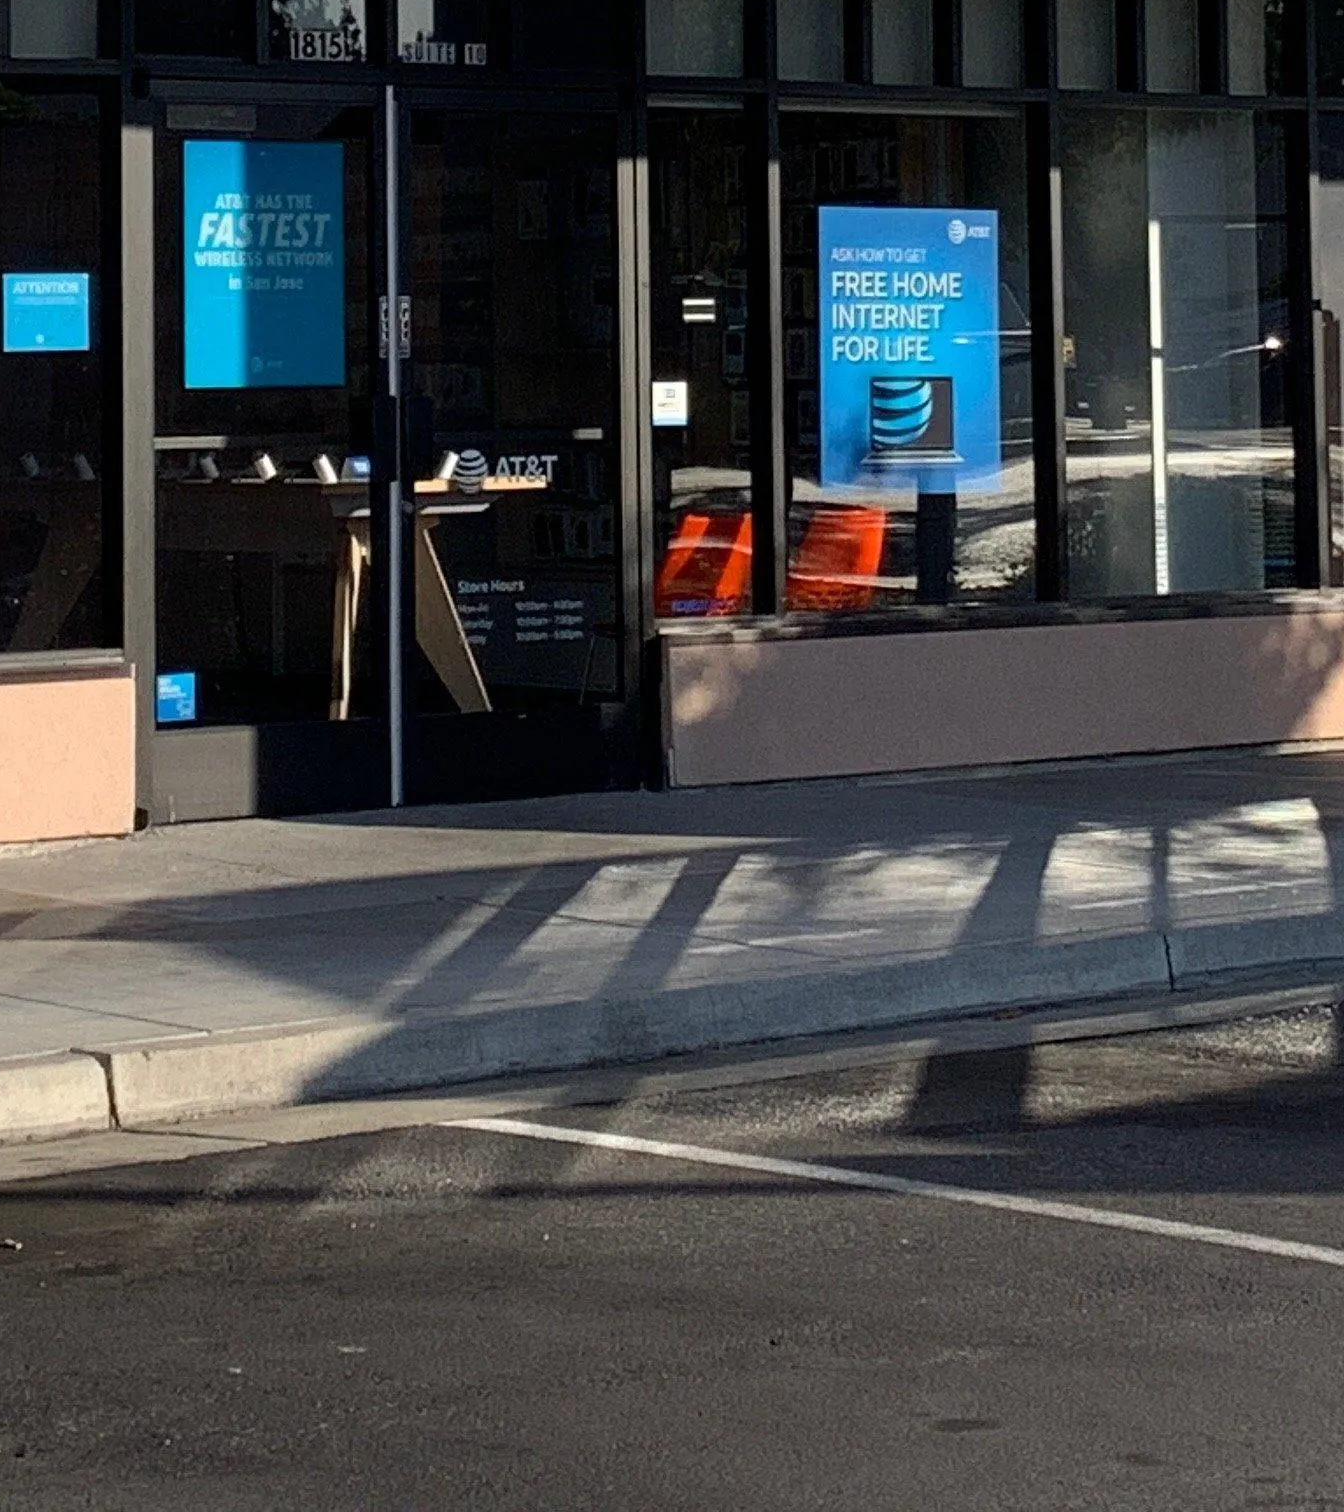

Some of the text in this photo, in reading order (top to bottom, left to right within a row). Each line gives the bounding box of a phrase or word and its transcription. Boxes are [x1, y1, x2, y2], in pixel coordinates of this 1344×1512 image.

[215, 193, 313, 209] AT&T HAS THE
[197, 212, 331, 248] FASTEST
[968, 226, 992, 238] AT&T
[194, 250, 334, 267] WIRELESS NETWORK
[831, 247, 927, 263] ASK HOW TO GET
[229, 273, 242, 290] in
[831, 271, 963, 299] FREE HOME
[831, 304, 945, 330] INTERNET
[831, 335, 936, 362] FOR LIFE.
[494, 455, 559, 483] AT&T
[457, 579, 525, 594] Store Hours
